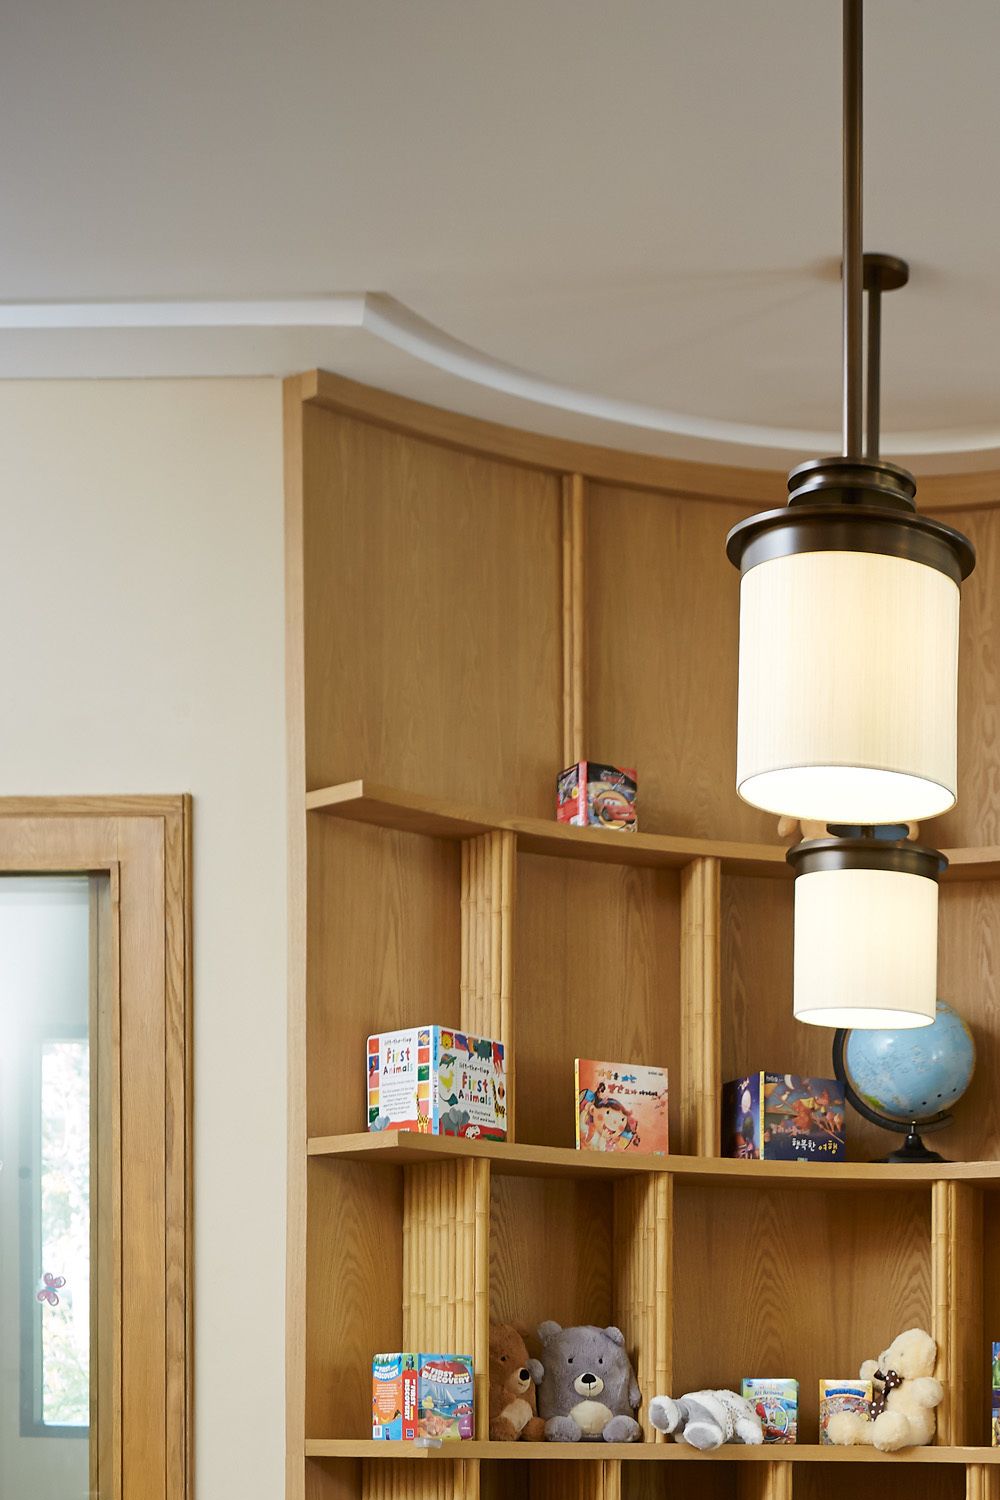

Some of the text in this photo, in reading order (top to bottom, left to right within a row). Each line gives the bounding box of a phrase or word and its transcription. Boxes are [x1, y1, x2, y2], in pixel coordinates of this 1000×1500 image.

[386, 1047, 410, 1064] First
[383, 1062, 414, 1075] Animals
[461, 1071, 489, 1093] First
[458, 1089, 492, 1106] Animals
[421, 1370, 471, 1385] DISCOVERY
[431, 1367, 453, 1378] FIRST
